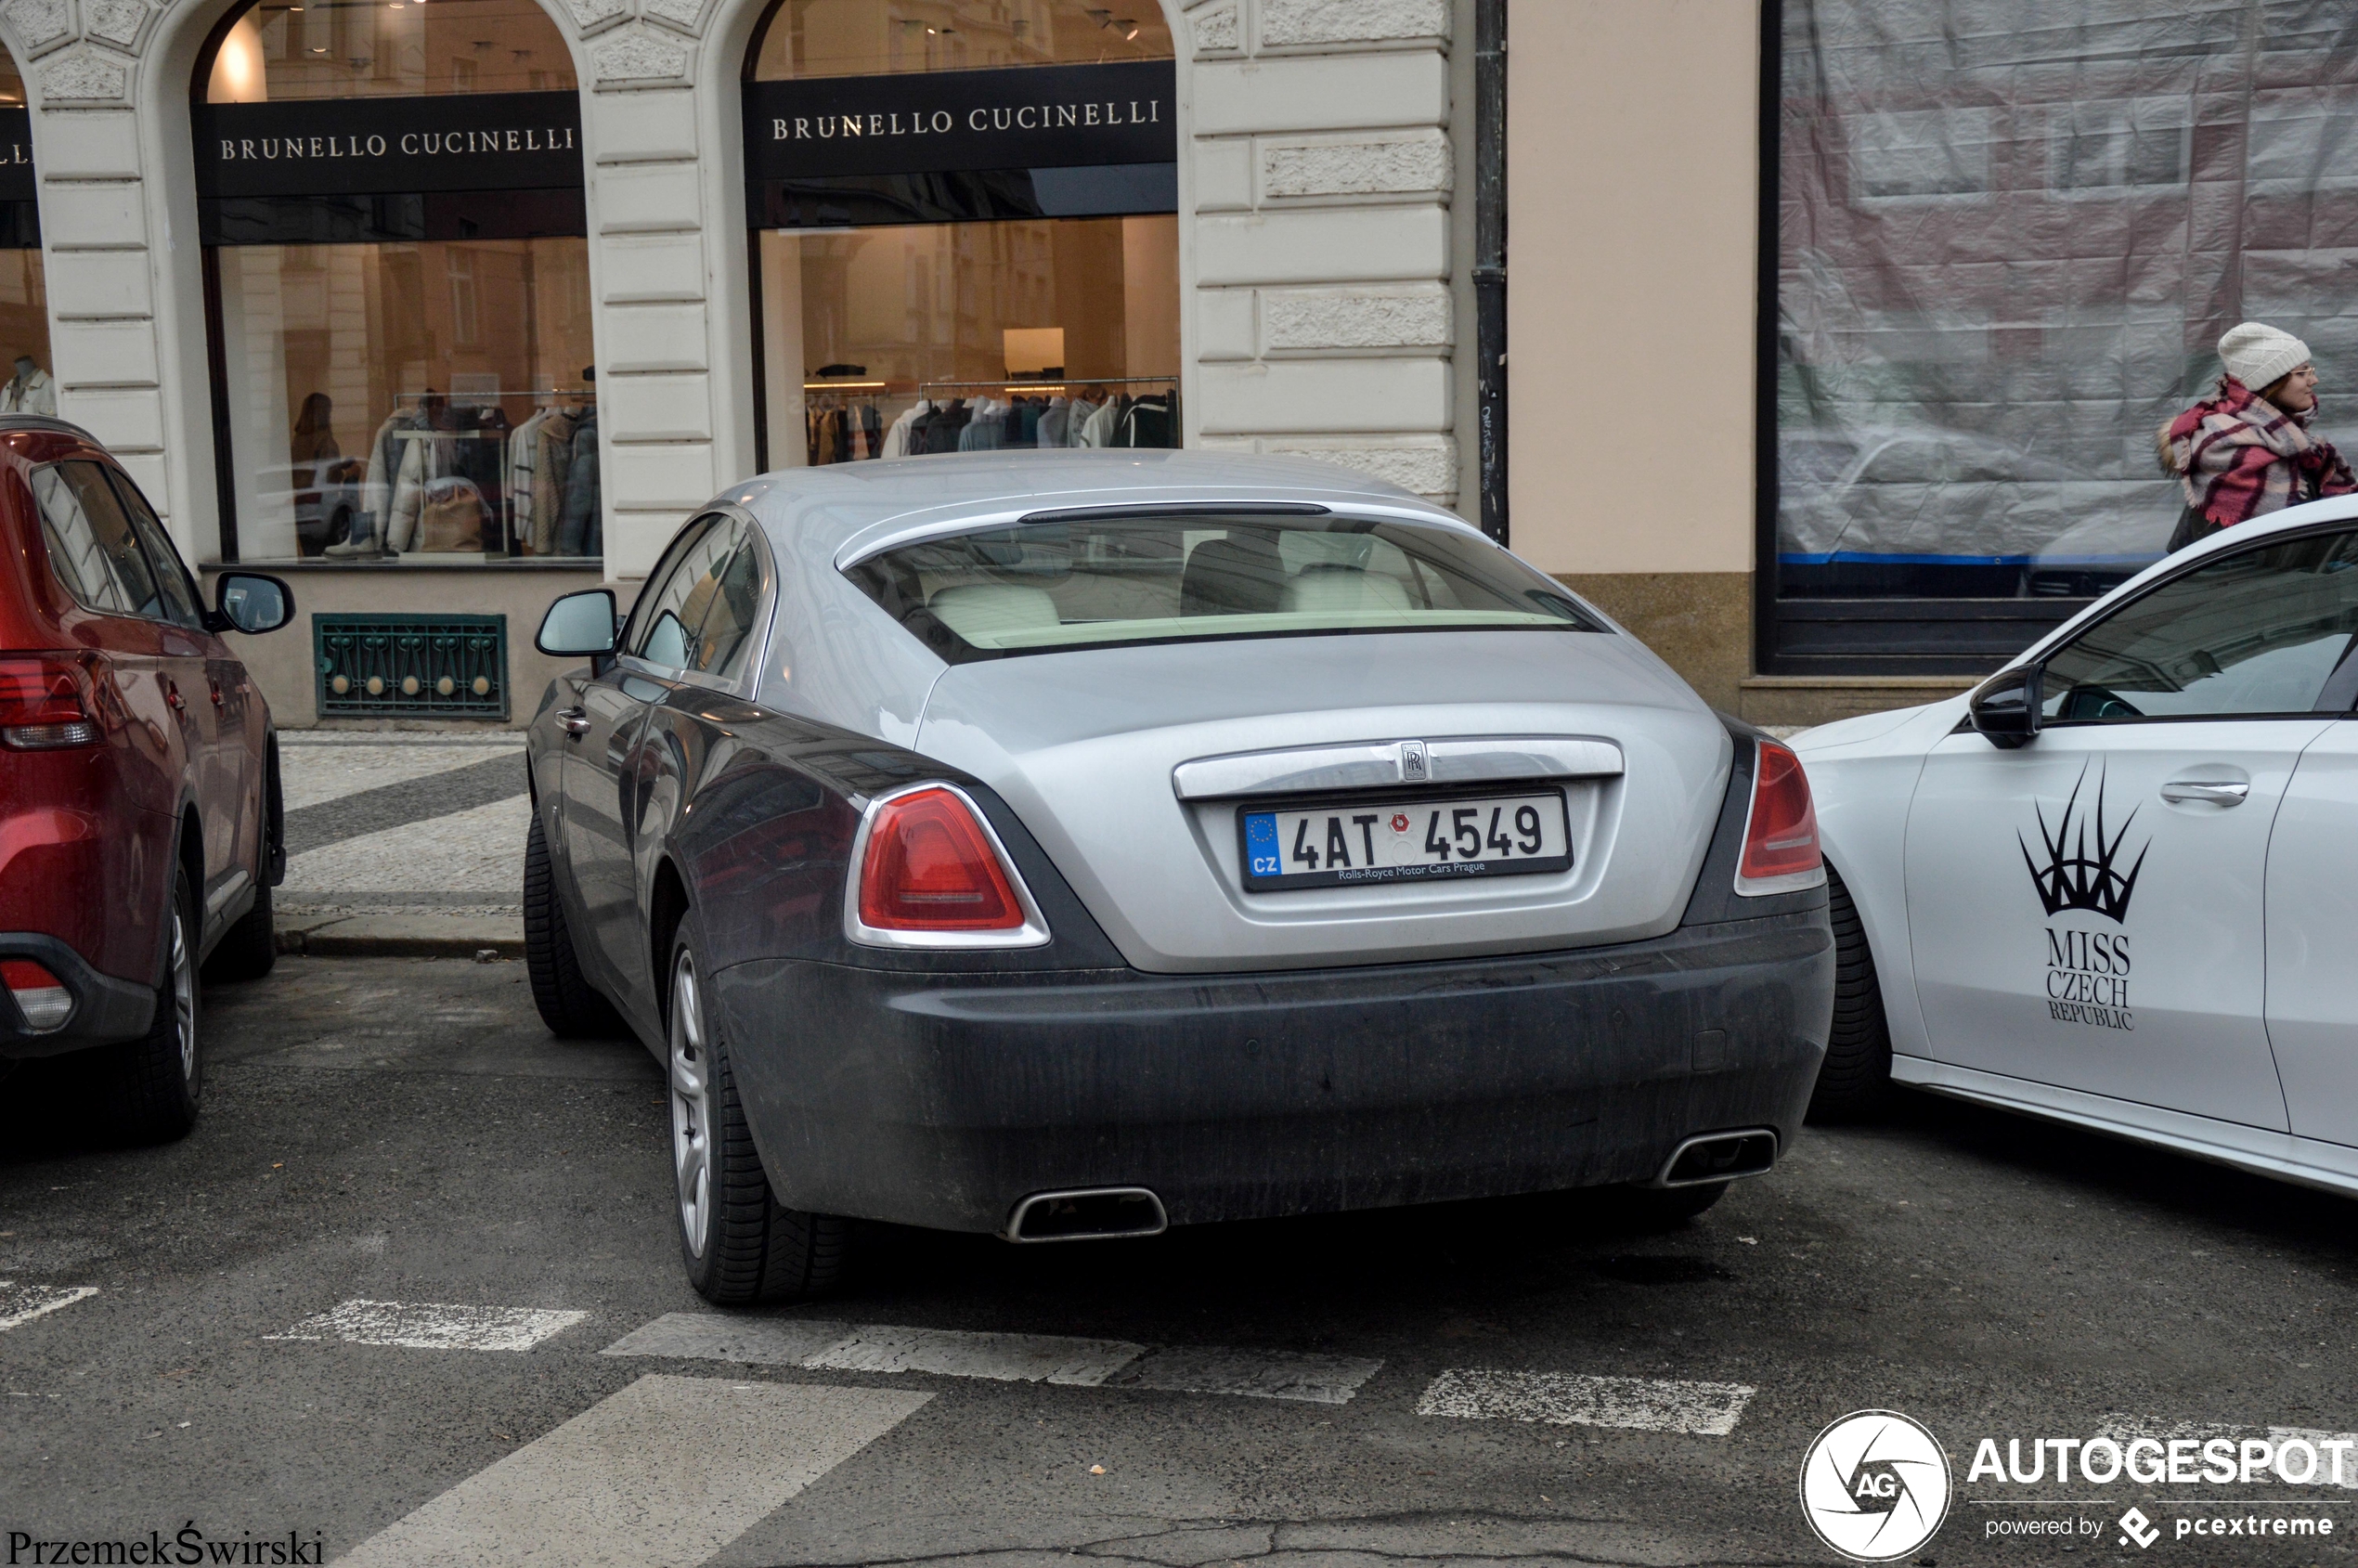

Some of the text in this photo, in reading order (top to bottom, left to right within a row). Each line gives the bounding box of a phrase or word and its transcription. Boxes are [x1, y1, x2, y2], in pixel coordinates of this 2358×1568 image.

[772, 100, 1160, 140] BRUNELLO CUCINELLI
[221, 128, 574, 161] BRUNELLO CUCINELLI
[1292, 805, 1542, 869] 4AT 4549
[1253, 857, 1277, 873] CZ
[1338, 862, 1485, 880] Rolls-Royce Motor Cars Prague
[2045, 927, 2131, 976] MISS
[2047, 970, 2130, 1008] CZECH
[2048, 1001, 2135, 1030] REPUBLIC
